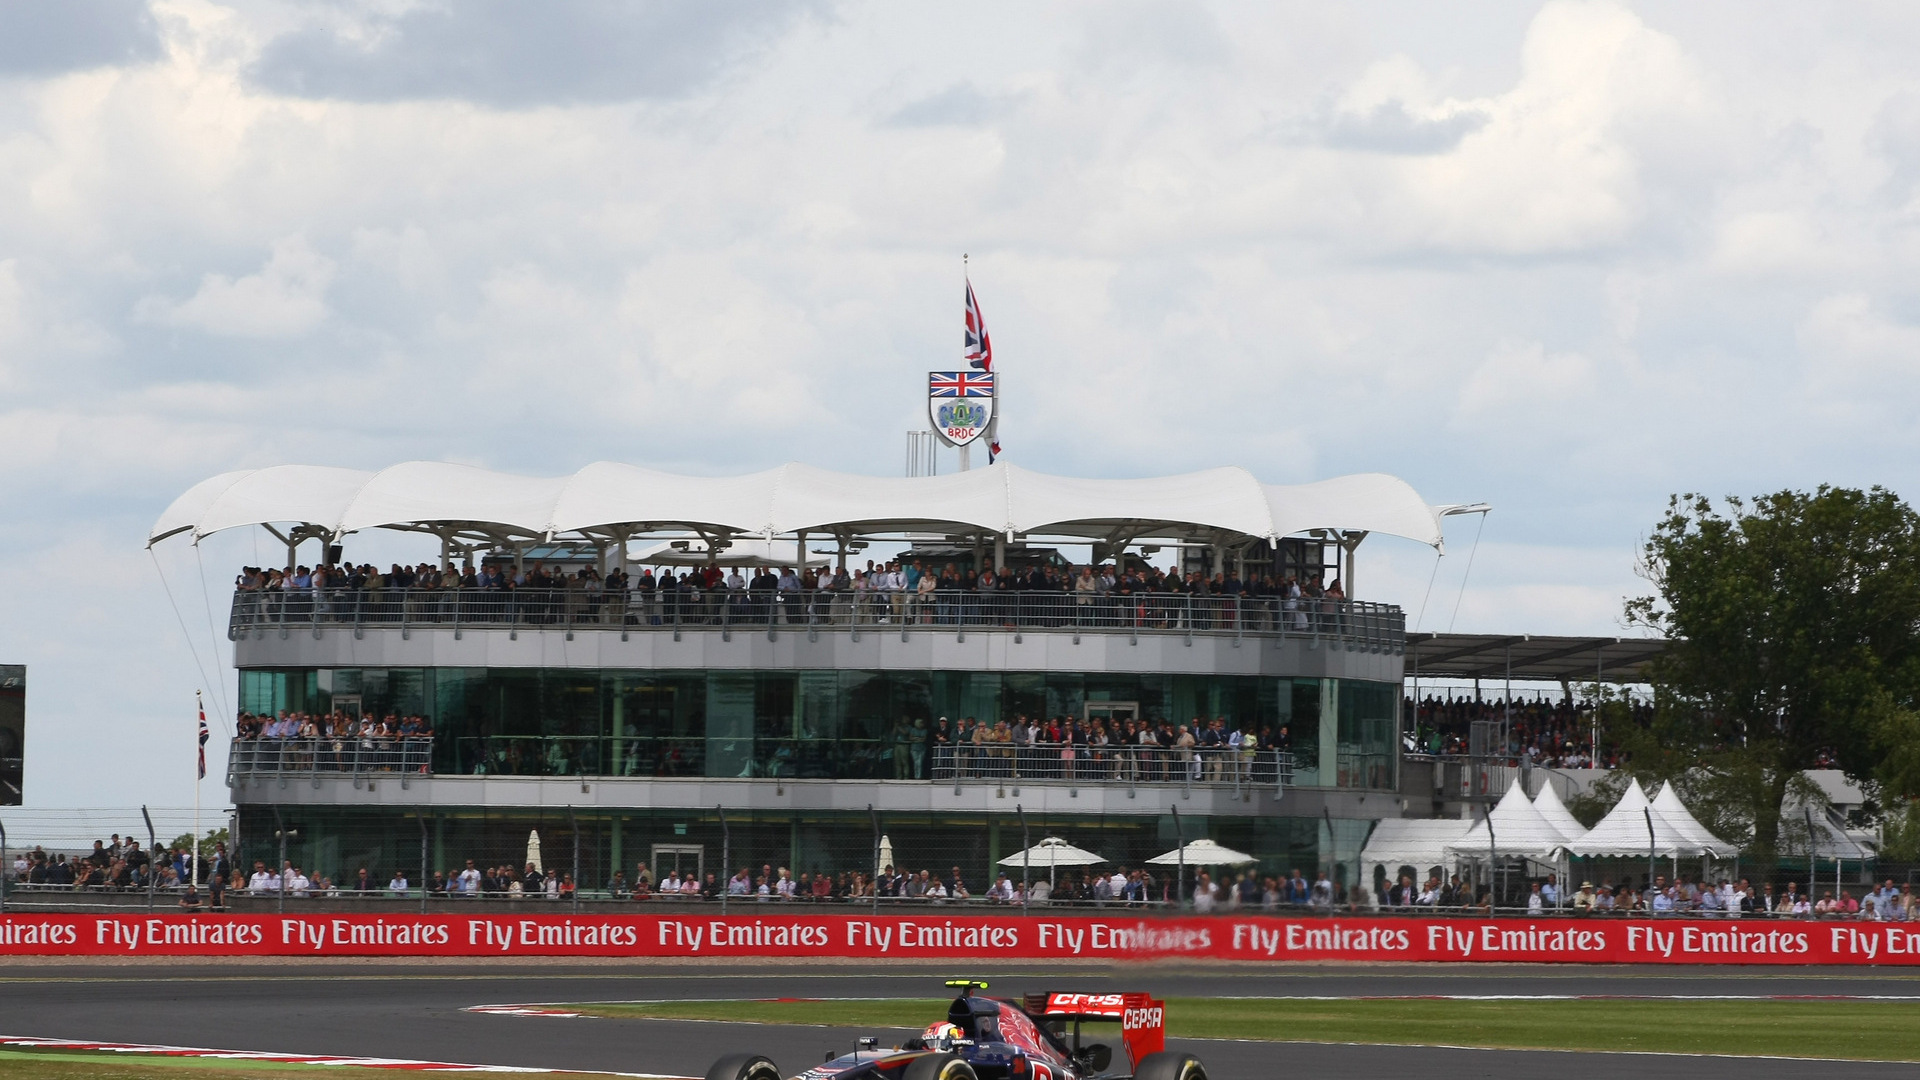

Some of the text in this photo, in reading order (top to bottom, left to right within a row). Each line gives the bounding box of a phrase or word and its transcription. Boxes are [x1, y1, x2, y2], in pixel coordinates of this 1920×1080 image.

[947, 428, 975, 439] BRDC
[0, 919, 77, 945] irates
[96, 919, 262, 949] Fly Emirates
[282, 919, 448, 949] Fly Emirates
[468, 920, 636, 950] Fly Emirates
[658, 920, 828, 950] Fly Emirates
[847, 921, 1017, 951] Fly Emirates
[1038, 923, 1084, 953] Fly
[1232, 924, 1409, 955] Fly Emirates
[1428, 925, 1605, 956] Fly Emirates
[1627, 926, 1808, 957] Fly Emirates
[1830, 927, 1879, 959] Fly
[1123, 1008, 1162, 1029] CEPSA
